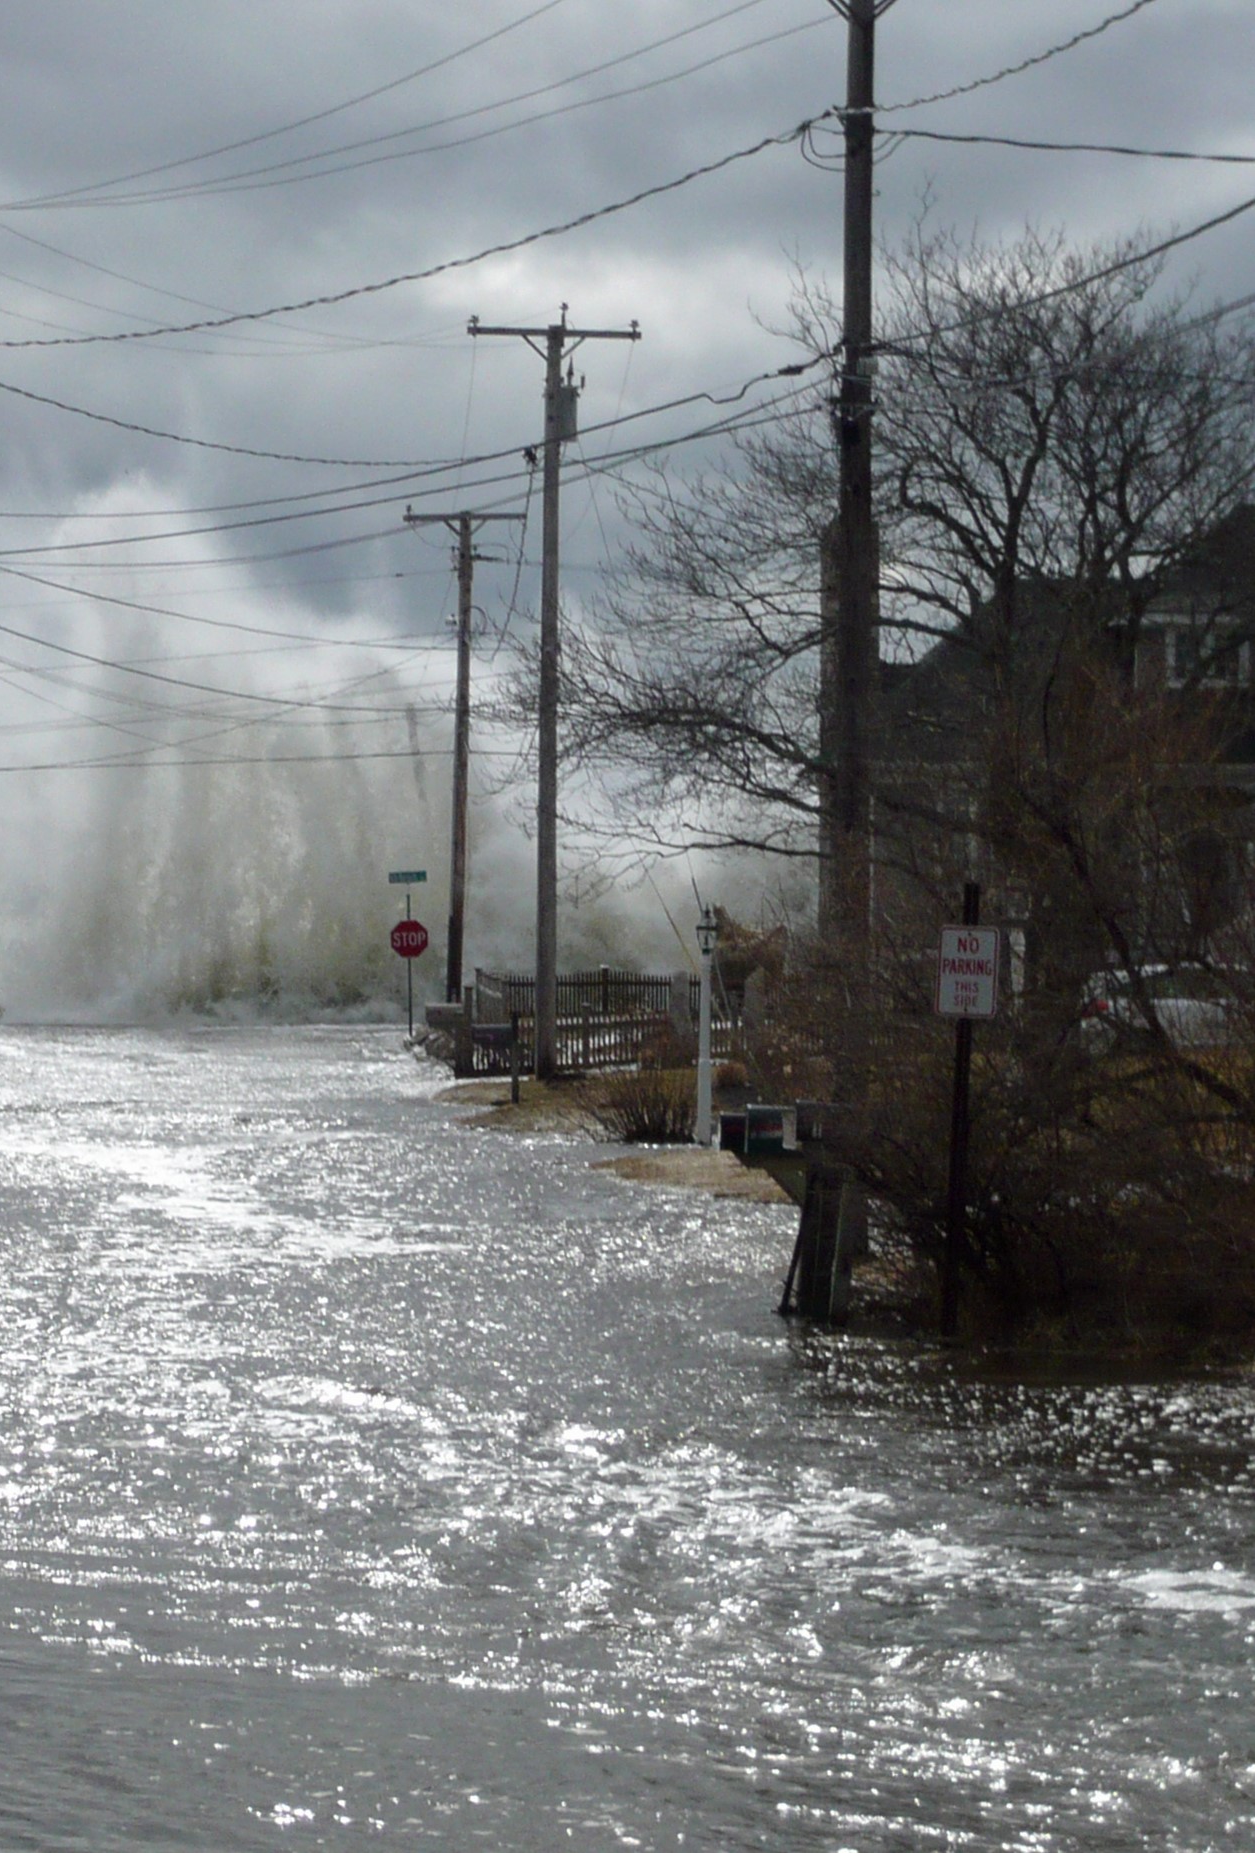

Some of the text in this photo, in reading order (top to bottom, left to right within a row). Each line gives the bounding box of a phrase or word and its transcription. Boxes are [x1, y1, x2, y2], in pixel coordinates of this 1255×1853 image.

[393, 932, 426, 947] STOP
[957, 937, 979, 954] NO
[942, 958, 992, 976] PARKING
[954, 981, 979, 994] THIS
[953, 994, 978, 1007] SIDE
